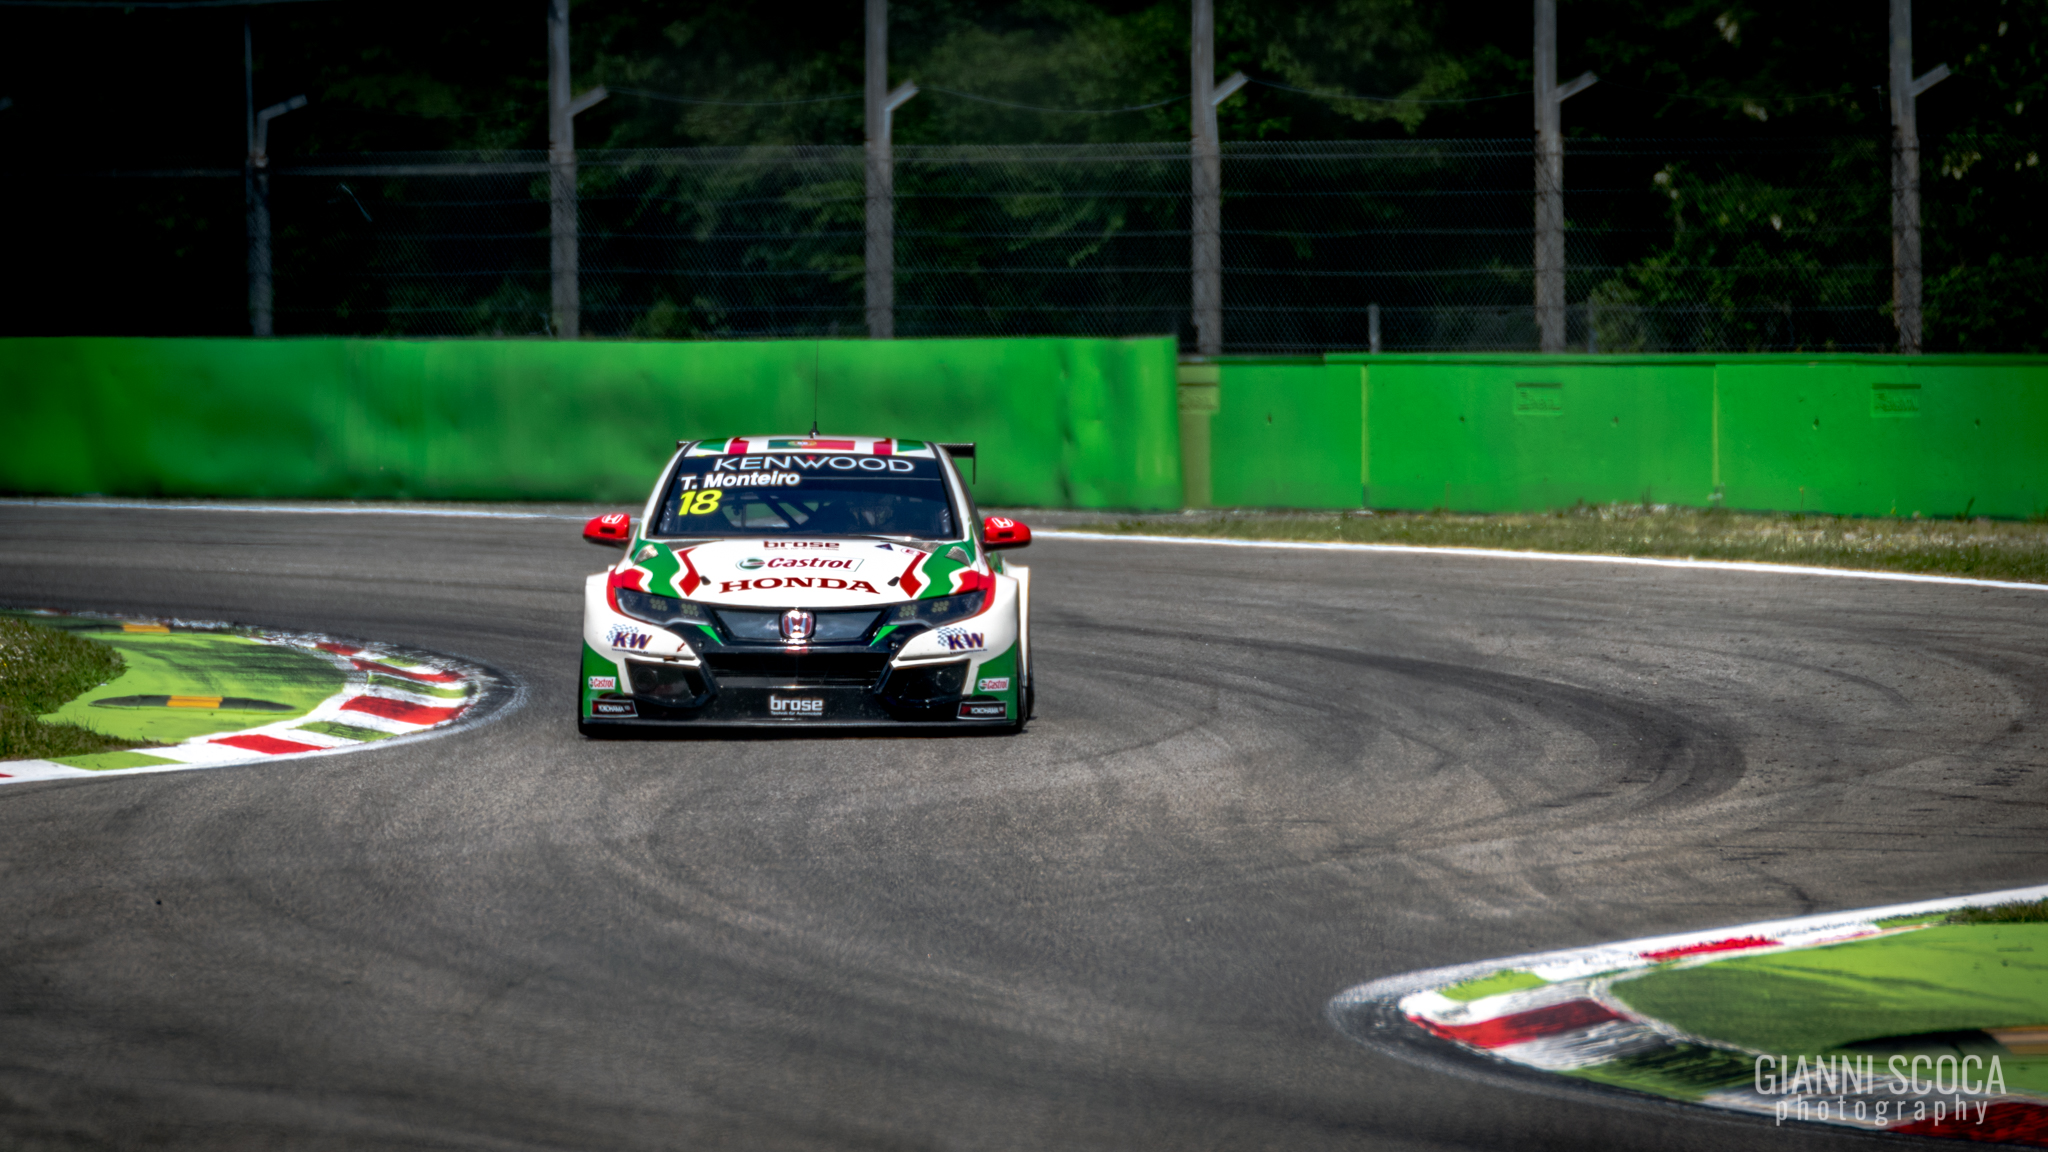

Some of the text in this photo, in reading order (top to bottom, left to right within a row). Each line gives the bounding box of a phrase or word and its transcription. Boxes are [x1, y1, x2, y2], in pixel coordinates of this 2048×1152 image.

[713, 454, 915, 473] KENWOOD
[680, 470, 801, 490] T. Monteiro
[678, 490, 723, 516] 18
[763, 540, 840, 549] brose
[767, 556, 853, 571] Castrol
[719, 576, 881, 595] HONDA
[612, 632, 653, 650] KW
[947, 632, 985, 650] KW
[593, 677, 614, 689] Castrol
[987, 679, 1008, 690] Castrol
[770, 695, 823, 711] brose
